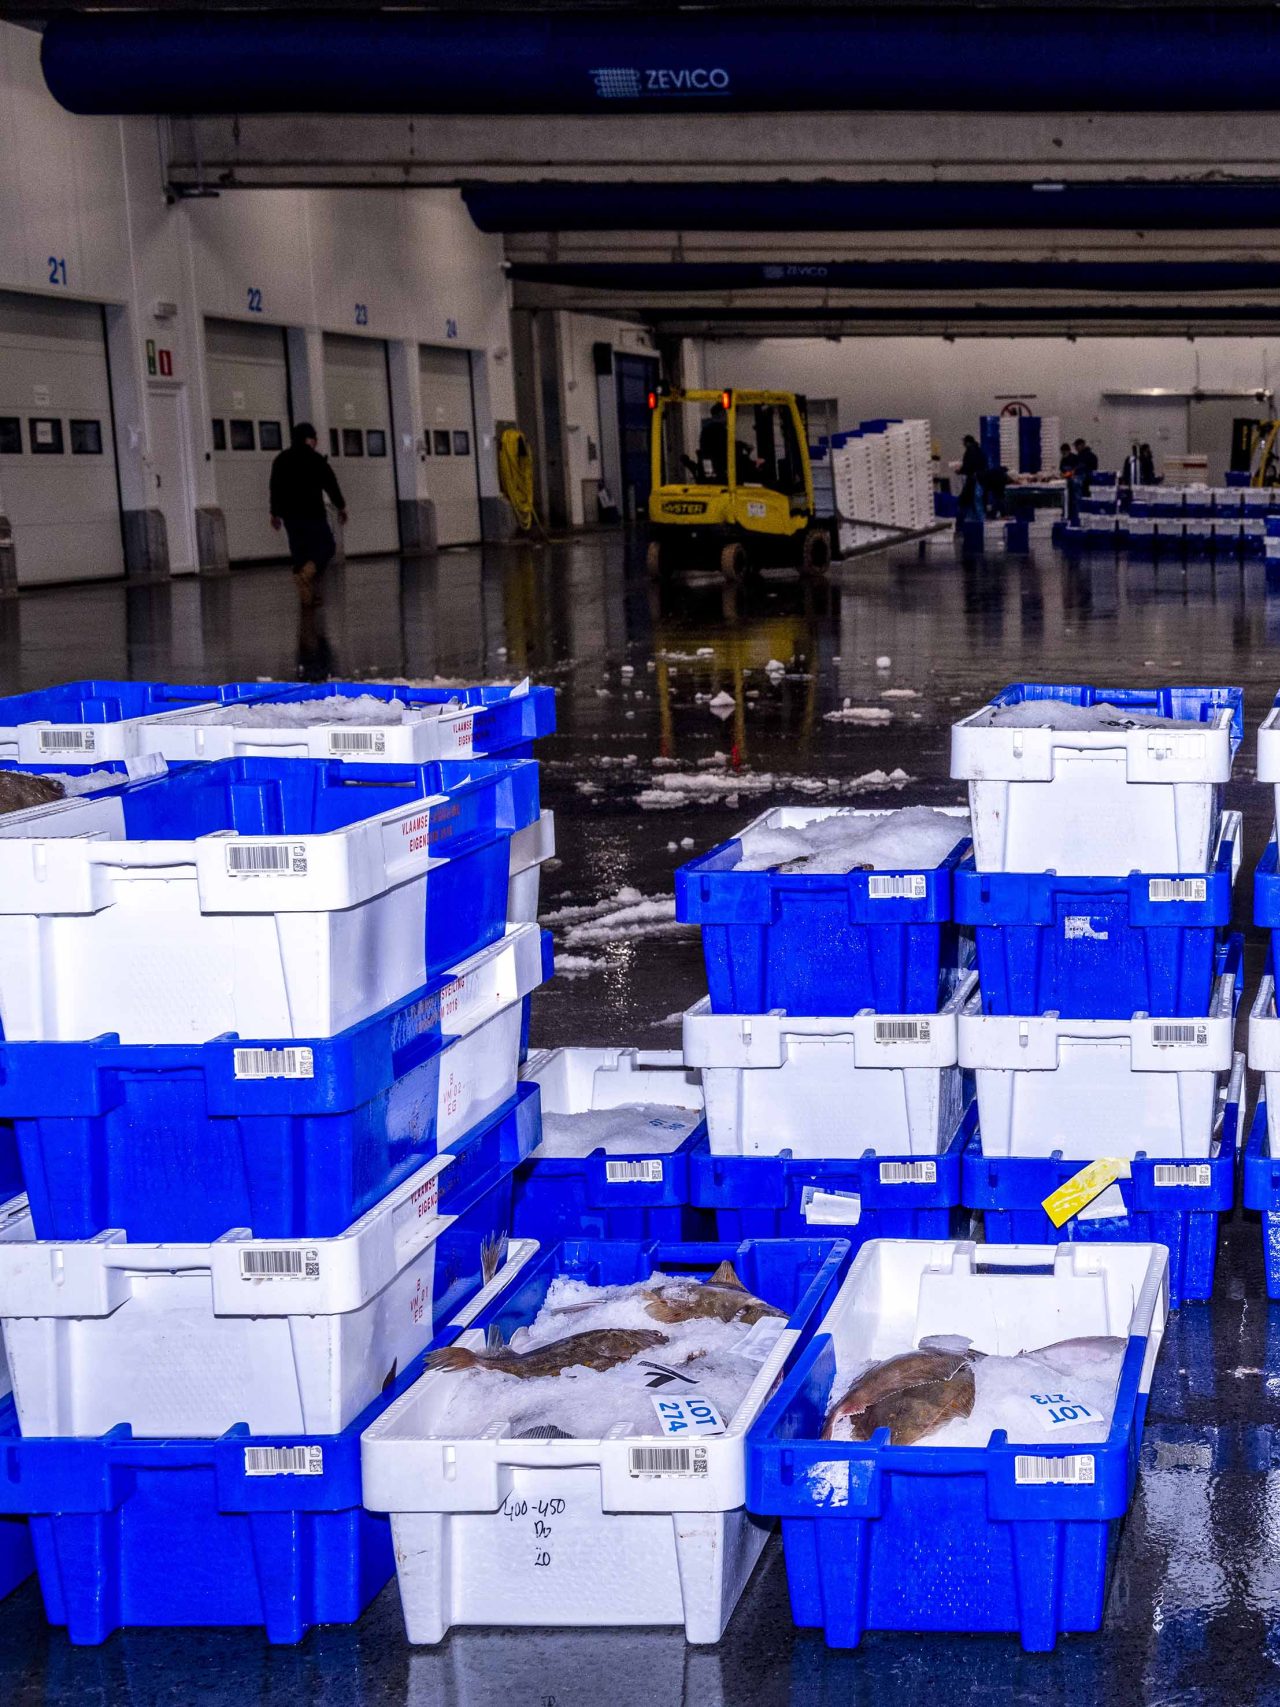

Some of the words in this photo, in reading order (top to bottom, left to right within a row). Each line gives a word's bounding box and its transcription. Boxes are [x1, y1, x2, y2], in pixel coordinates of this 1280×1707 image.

[645, 68, 729, 89] ZEVICO
[48, 256, 67, 286] 21
[247, 288, 263, 312] 22
[354, 302, 369, 326] 23
[402, 814, 428, 836] VLAAMSE
[1030, 1393, 1071, 1405] 273
[658, 1402, 688, 1433] 274
[685, 1400, 717, 1426] LOT
[1048, 1404, 1091, 1424] LOT
[503, 1498, 566, 1522] 400-450
